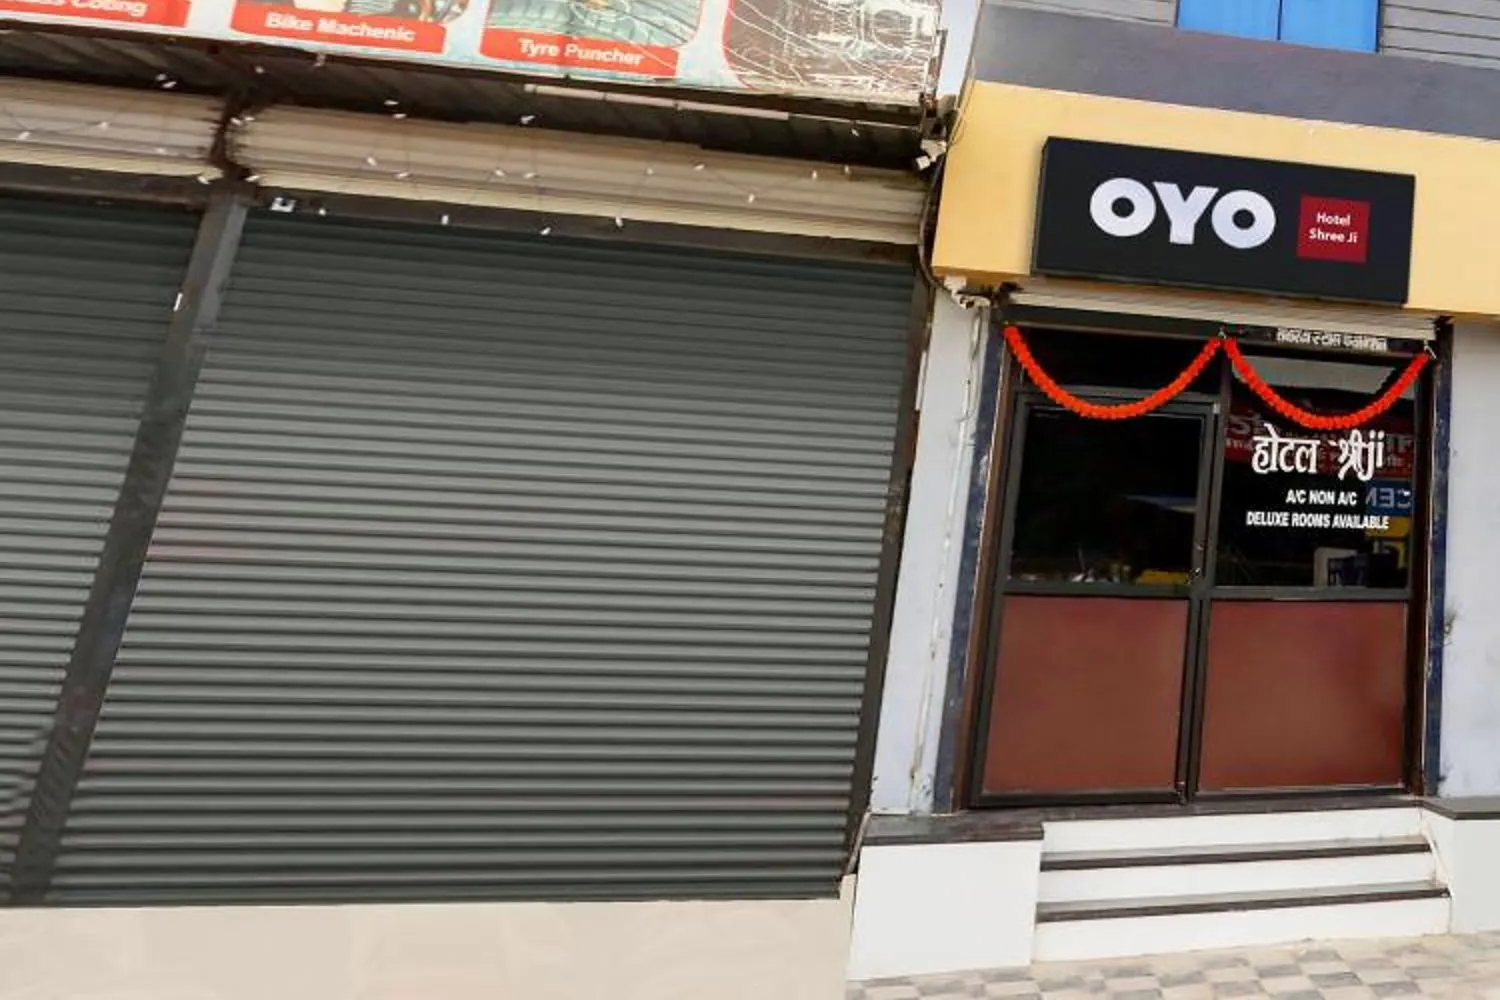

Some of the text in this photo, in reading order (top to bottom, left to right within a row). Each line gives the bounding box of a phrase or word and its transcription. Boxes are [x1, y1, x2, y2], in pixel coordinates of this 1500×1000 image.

[265, 11, 416, 42] Bike Machenic
[518, 37, 643, 65] Tyre Puncher
[1089, 177, 1277, 249] OYO
[1316, 211, 1351, 226] Hotel
[1309, 227, 1358, 244] Shree Ji
[1251, 422, 1321, 475] होटल
[1309, 490, 1337, 505] NON
[1246, 510, 1390, 530] DELUXE ROOMS AVAILABLE
